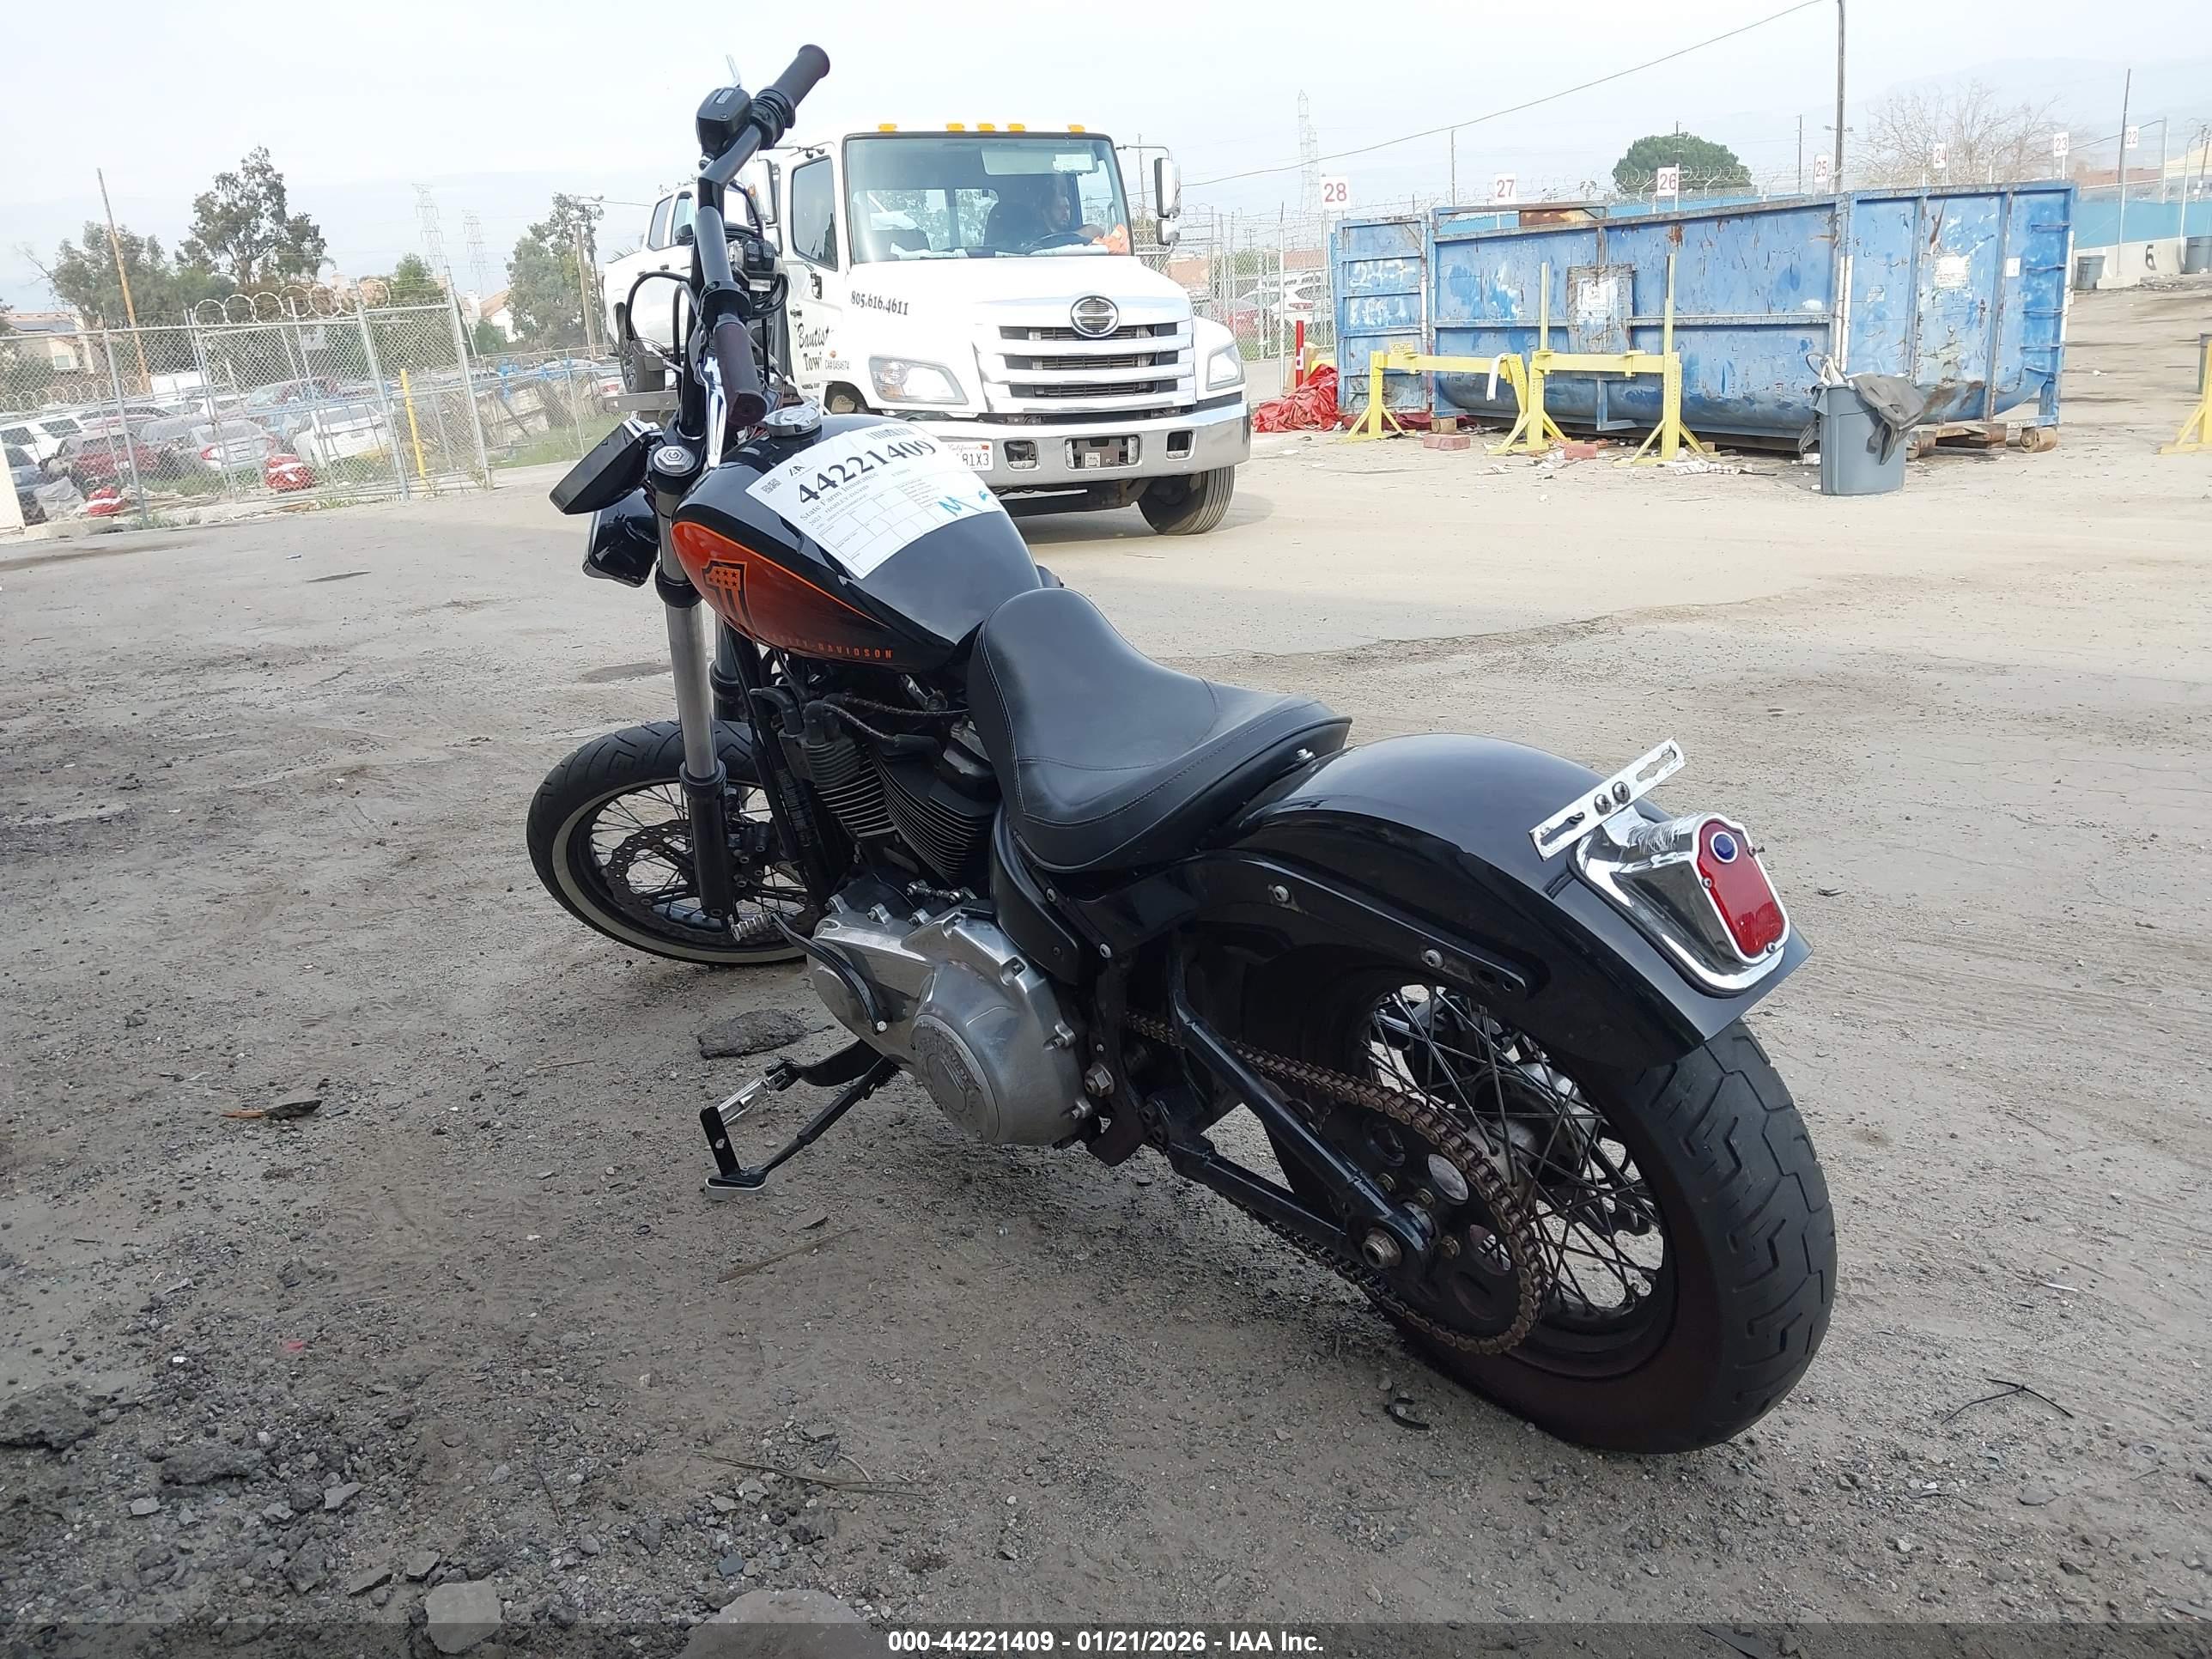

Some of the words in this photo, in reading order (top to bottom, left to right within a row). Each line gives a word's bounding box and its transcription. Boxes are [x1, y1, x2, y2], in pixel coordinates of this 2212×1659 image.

[1935, 147, 1948, 164] 24
[2055, 137, 2068, 152] 23
[1815, 160, 1827, 178] 25
[1323, 182, 1347, 203] 28
[1497, 179, 1515, 198] 27
[1659, 173, 1676, 191] 26
[2145, 244, 2157, 270] 6
[851, 290, 909, 316] 805.616.4611
[796, 322, 834, 349] Bautist
[799, 439, 937, 504] 44221409
[799, 506, 821, 521] State
[820, 490, 842, 507] Farm
[841, 471, 879, 492] Insurance
[766, 631, 894, 659] LEY-DAVIDSON
